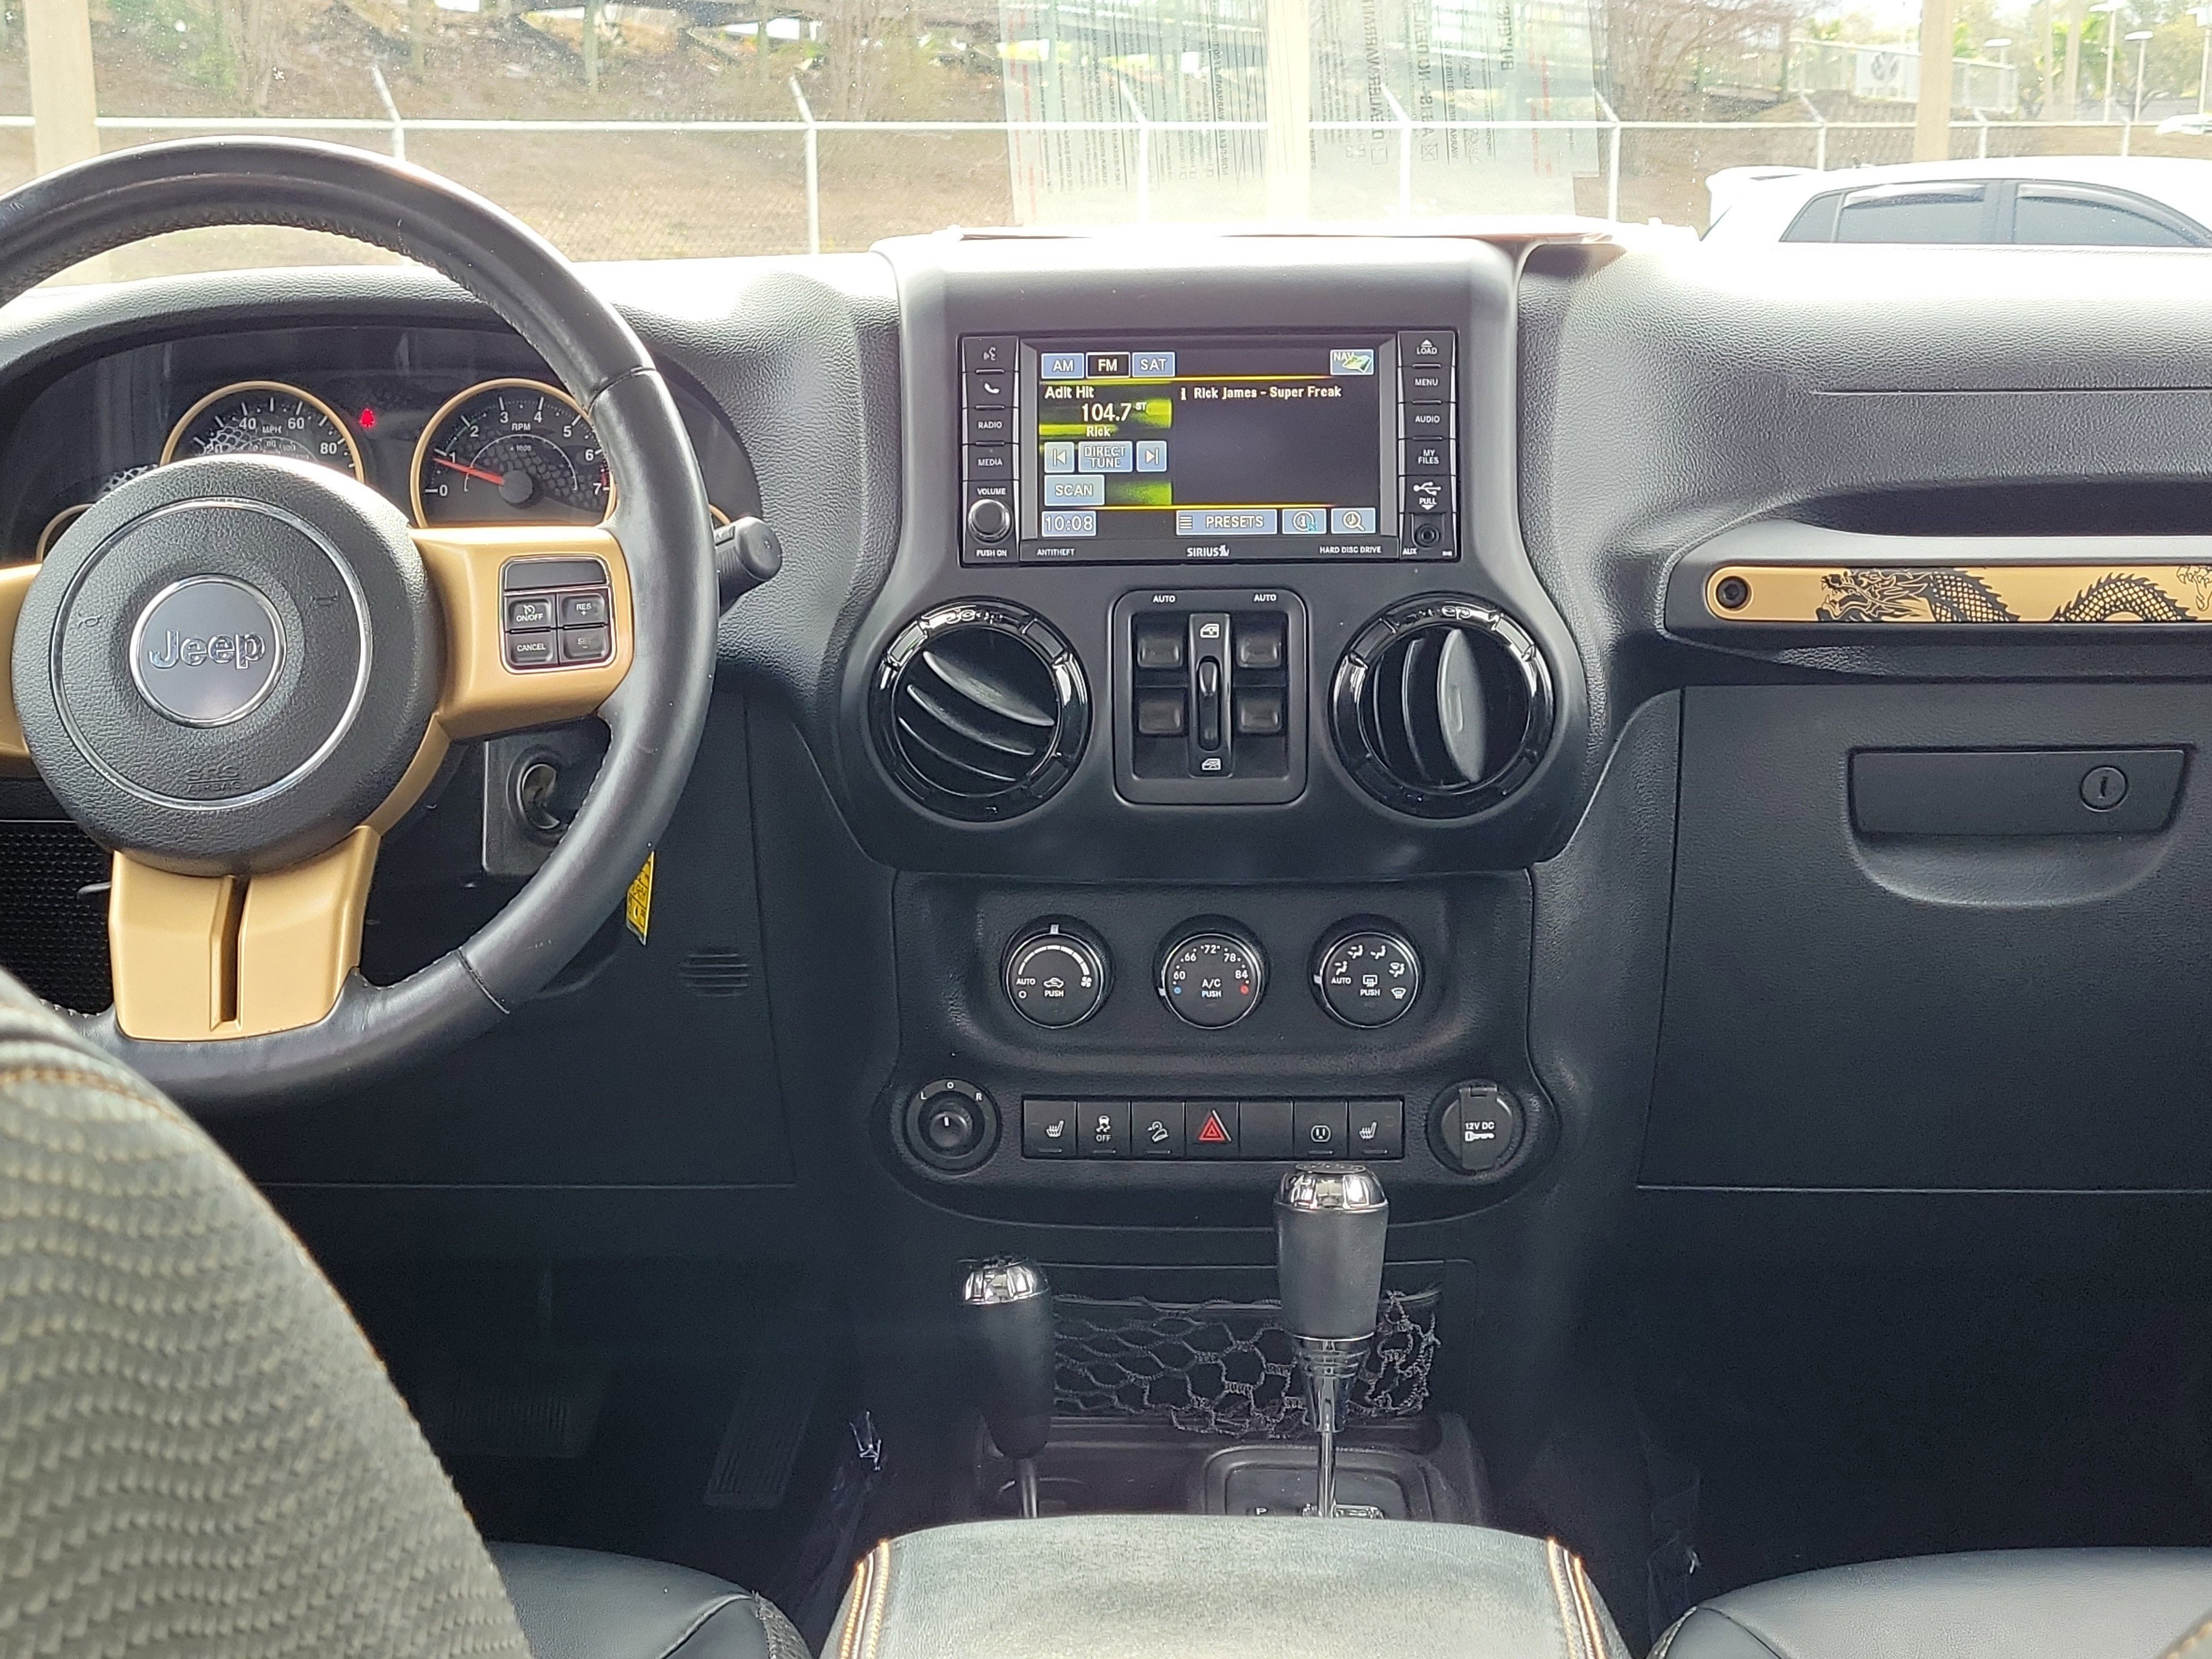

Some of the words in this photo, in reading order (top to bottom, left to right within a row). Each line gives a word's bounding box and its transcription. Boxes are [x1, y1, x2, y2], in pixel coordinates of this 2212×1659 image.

[1334, 352, 1355, 361] NAV
[1417, 347, 1437, 355] LOAD
[1052, 359, 1074, 373] AM
[1098, 359, 1118, 372] FM
[1140, 358, 1166, 371] SAT
[1415, 379, 1438, 387] MENU
[1076, 386, 1095, 399] Hit
[1194, 387, 1218, 399] Rick
[1221, 387, 1257, 400] James
[1270, 386, 1305, 399] Super
[1307, 386, 1342, 398] Freak
[534, 411, 543, 423] 4
[1082, 402, 1132, 422] 104.7
[1135, 402, 1147, 410] ST
[239, 417, 256, 430] 40
[287, 417, 304, 429] 60
[500, 412, 509, 424] 3
[1415, 415, 1440, 424] AUDIO
[511, 423, 531, 431] RPM
[978, 421, 1003, 430] RADIO
[470, 426, 479, 437] 2
[563, 426, 572, 437] 5
[1086, 426, 1111, 437] Rick
[320, 442, 337, 454] 80
[1084, 446, 1126, 458] DIRECT
[449, 452, 456, 463] 1
[585, 450, 594, 461] 6
[978, 459, 1003, 467] MEDIA
[1091, 458, 1122, 469] TUNE
[439, 485, 448, 496] 0
[592, 483, 602, 495] 7
[1055, 484, 1093, 496] SCAN
[1045, 516, 1093, 532] 10:08
[1206, 515, 1264, 529] PRESETS
[1036, 548, 1075, 556] ANTITHEFT
[1360, 545, 1381, 554] DRIVE
[1153, 595, 1176, 603] AUTO
[1254, 594, 1277, 602] AUTO
[576, 603, 592, 611] RES
[516, 613, 544, 622] ON/OFF
[148, 630, 266, 670] Jeep
[517, 643, 546, 652] CANCEL
[1204, 945, 1217, 953] 72
[1184, 952, 1197, 961] 66
[1223, 953, 1237, 962] 78
[1173, 971, 1186, 980] 60
[1235, 970, 1248, 979] 84
[1201, 979, 1221, 989] A/C
[921, 1091, 927, 1100] L
[975, 1092, 983, 1101] R
[1465, 1121, 1480, 1130] 12V
[1481, 1121, 1494, 1130] DC
